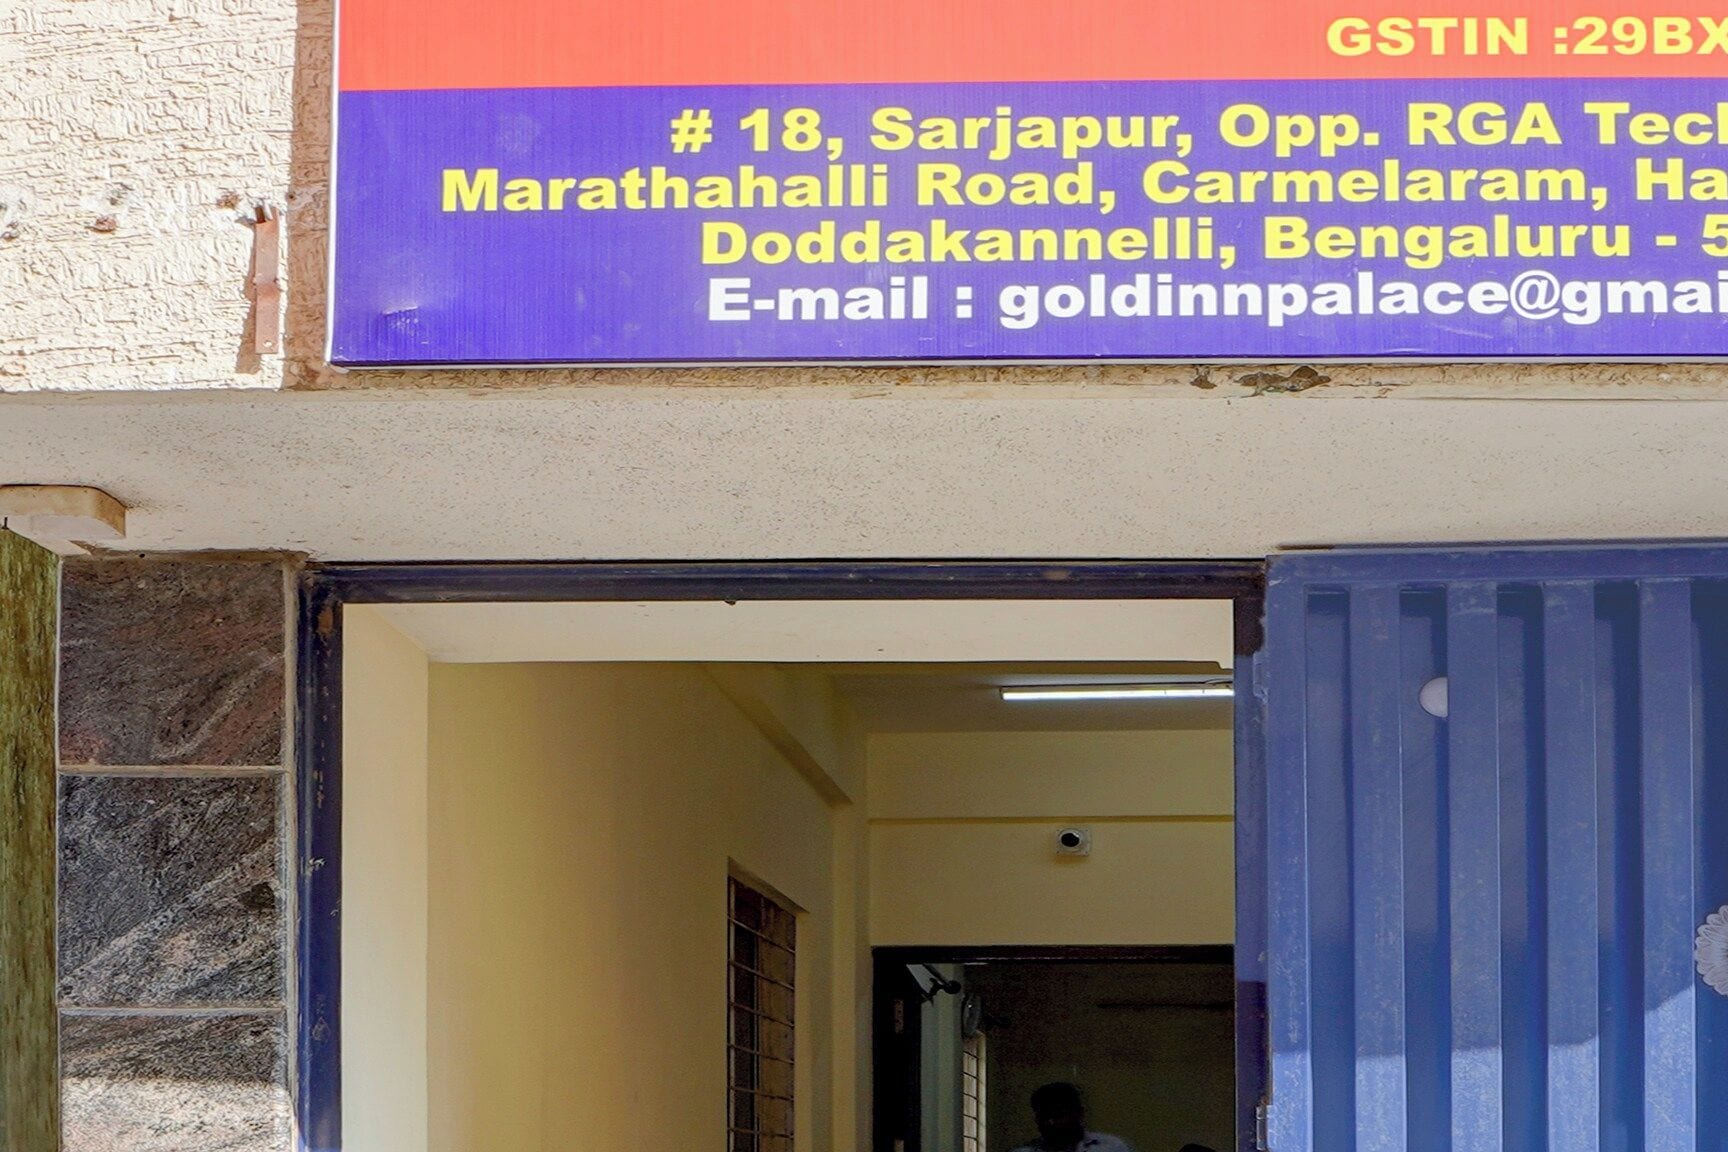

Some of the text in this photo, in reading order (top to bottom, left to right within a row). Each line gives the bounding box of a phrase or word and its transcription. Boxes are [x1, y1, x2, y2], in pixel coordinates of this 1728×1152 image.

[1325, 15, 1529, 57] GSTIN
[669, 107, 714, 155] #
[738, 107, 845, 162] 18,
[868, 105, 1194, 161] Sarjapur,
[1218, 102, 1381, 159] Opp.
[1406, 101, 1564, 147] RGA
[441, 162, 889, 213] Marathahalli
[916, 160, 1117, 215] Road,
[1141, 157, 1609, 213] Carmelaram,
[700, 214, 1237, 271] Doddakannelli,
[1263, 212, 1632, 271] Bengaluru
[1654, 234, 1678, 248] -
[706, 275, 930, 322] E-mail
[955, 285, 974, 320] :
